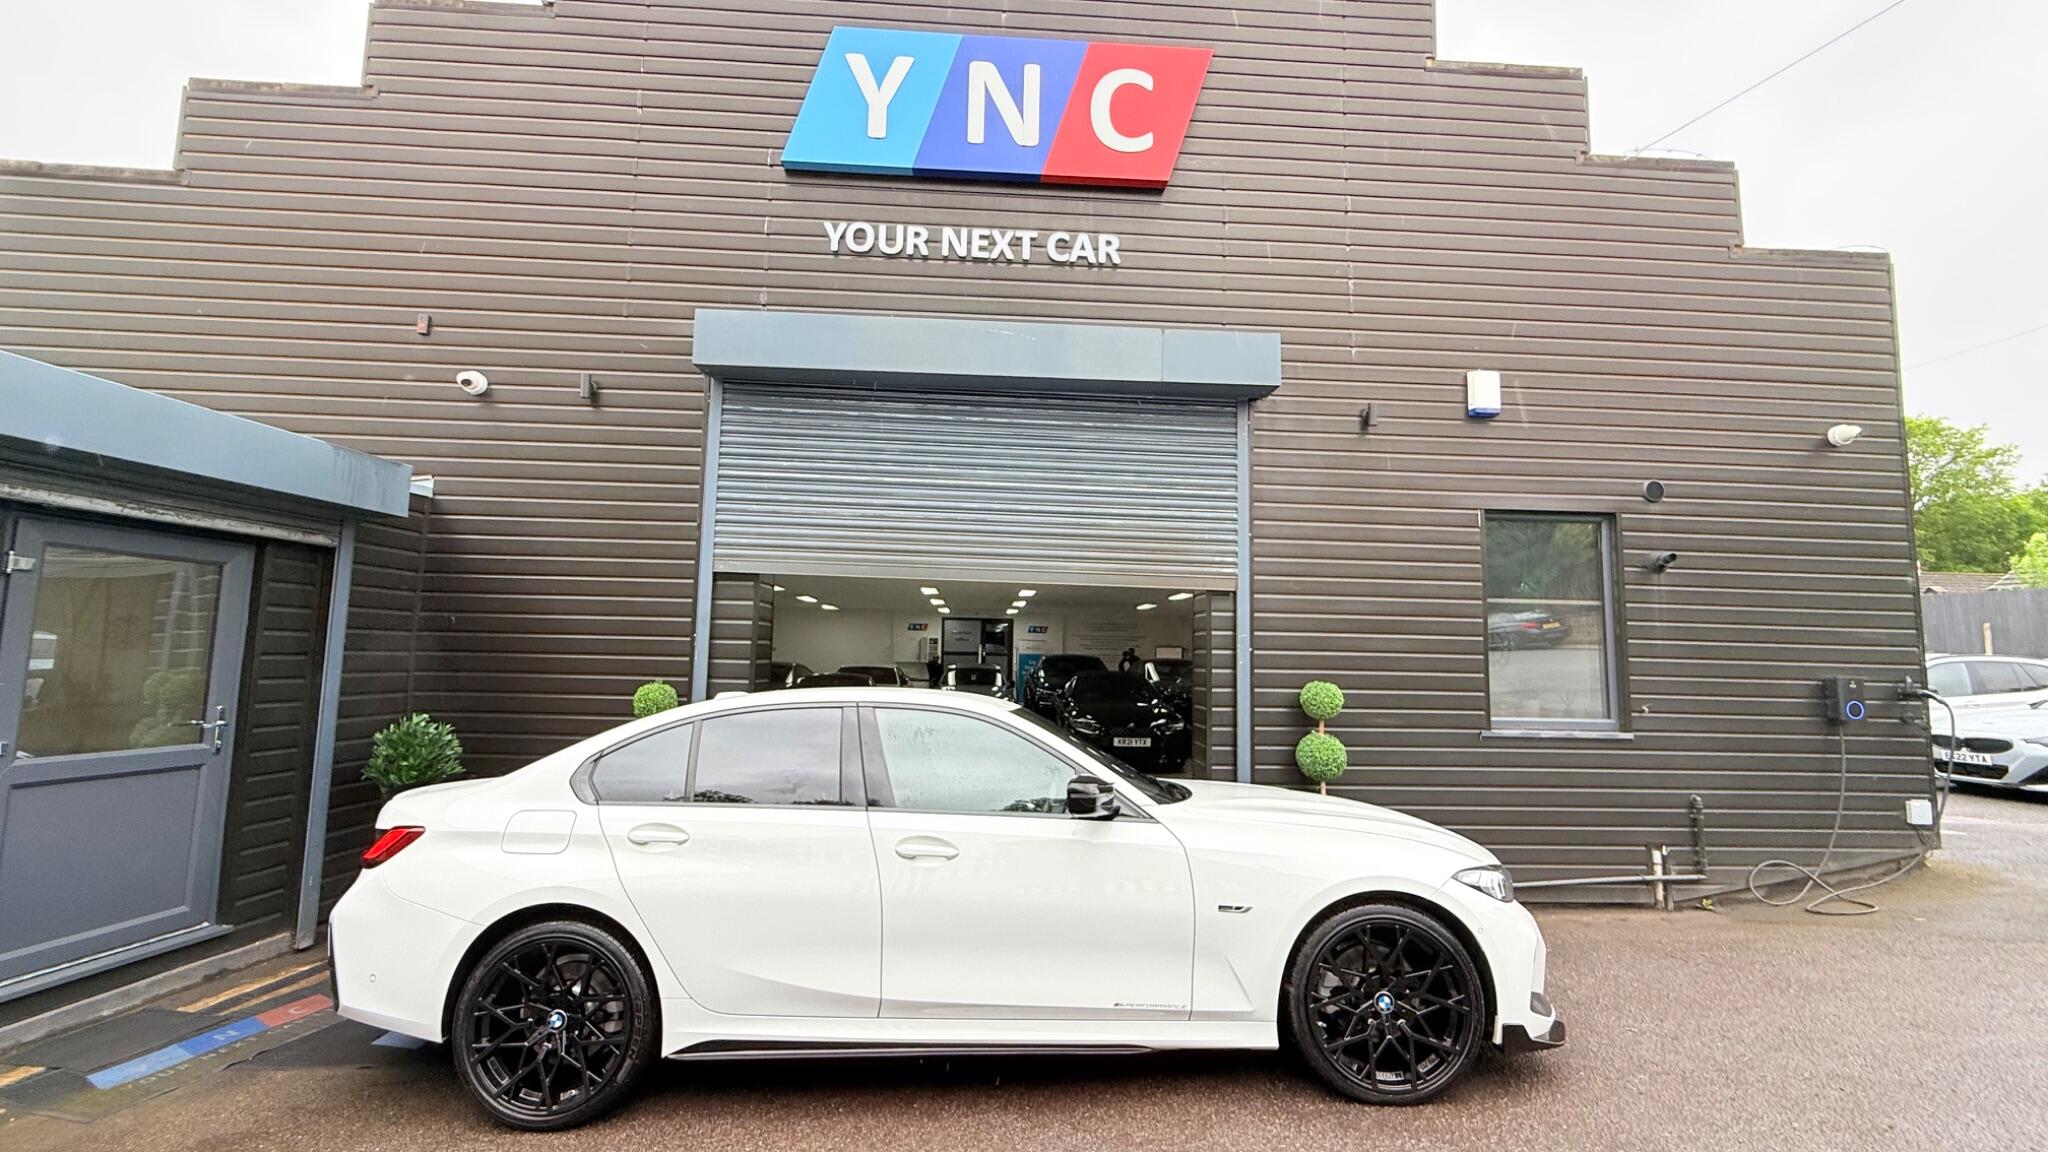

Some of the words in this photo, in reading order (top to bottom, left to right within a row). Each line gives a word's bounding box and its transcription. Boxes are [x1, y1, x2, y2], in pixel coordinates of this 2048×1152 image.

[844, 52, 1154, 153] YNC
[823, 221, 930, 257] YOUR
[941, 225, 1038, 261] NEXT
[1046, 230, 1121, 264] CAR
[1944, 751, 1967, 761] E22
[1968, 754, 1988, 763] YTA
